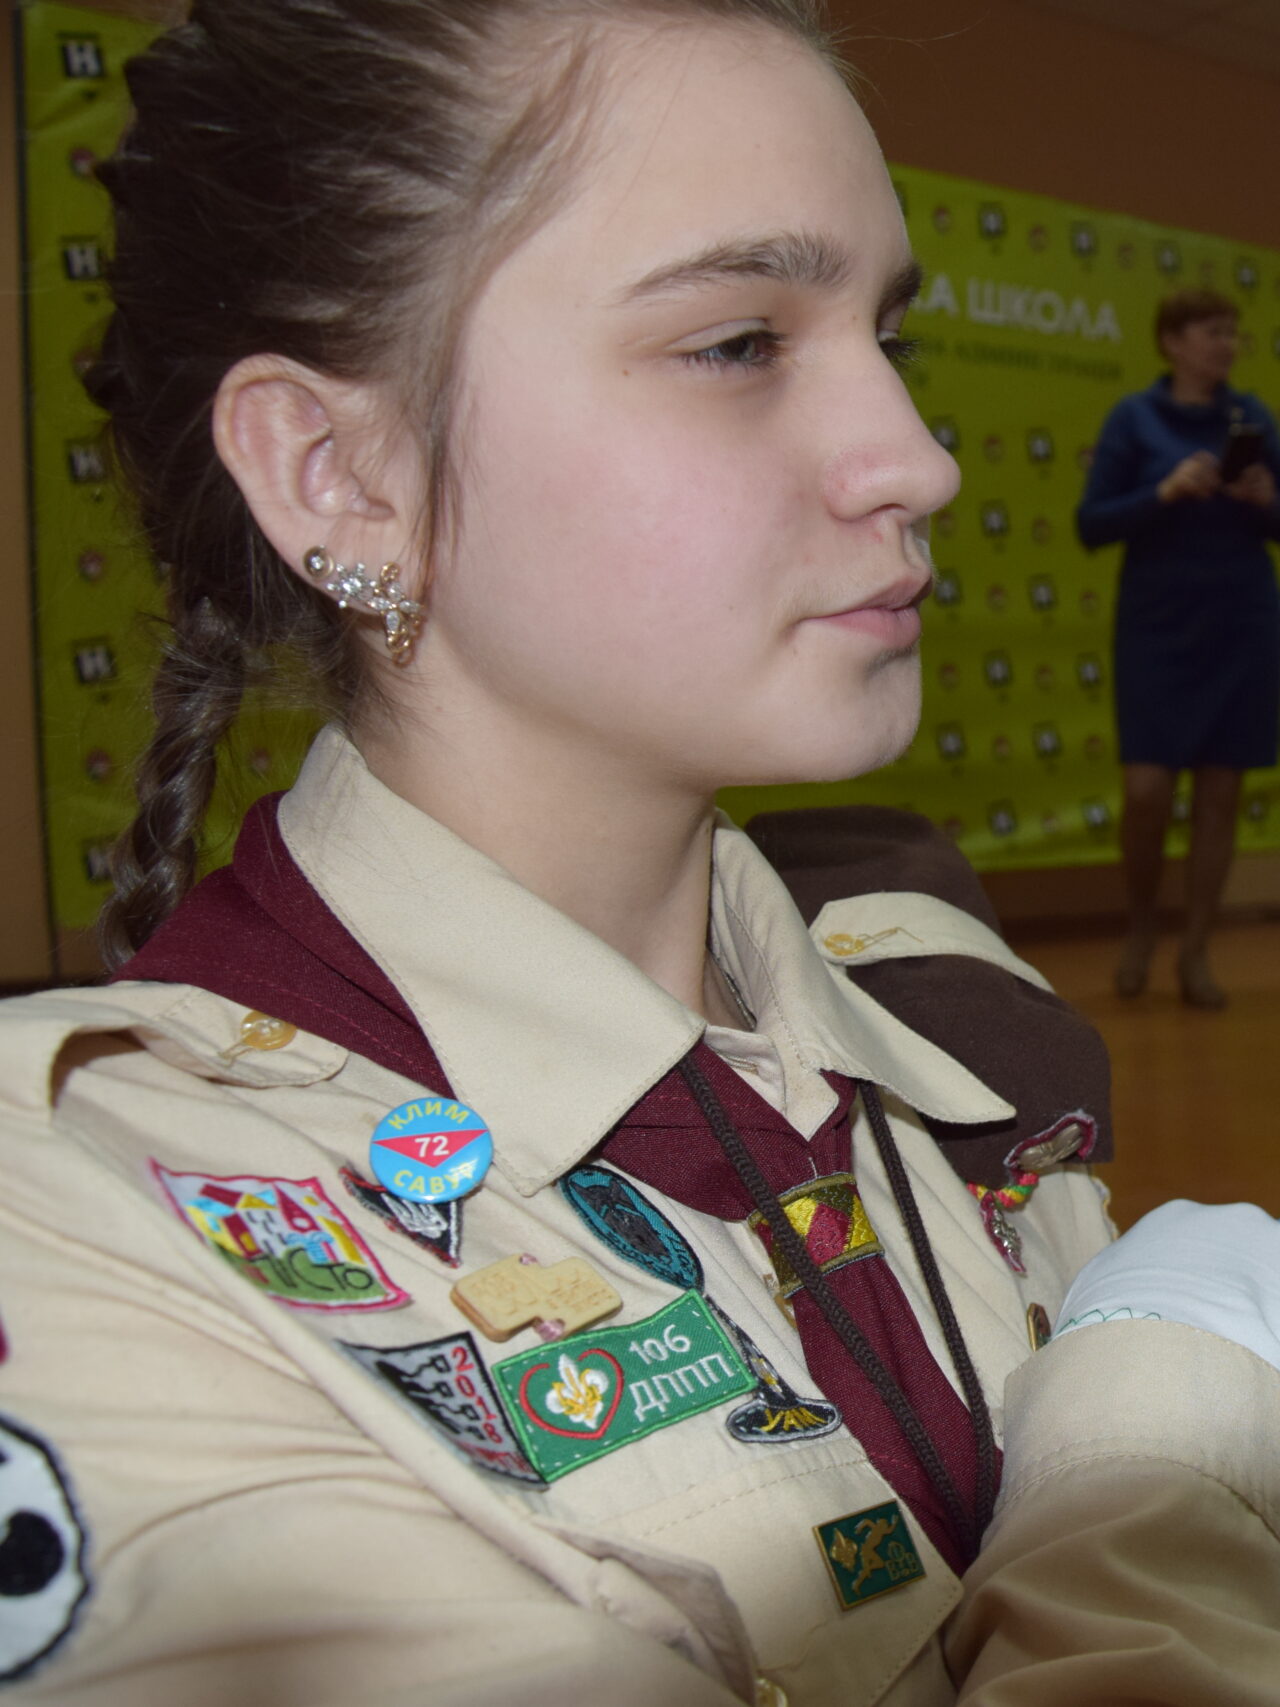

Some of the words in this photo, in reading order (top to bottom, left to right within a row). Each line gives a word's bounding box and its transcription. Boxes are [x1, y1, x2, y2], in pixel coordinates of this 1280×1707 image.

[966, 278, 1121, 341] ШКОЛА
[387, 1101, 470, 1130] КЛИМ
[415, 1135, 450, 1158] 72
[629, 1324, 691, 1366] 106
[629, 1352, 735, 1423] ДППП
